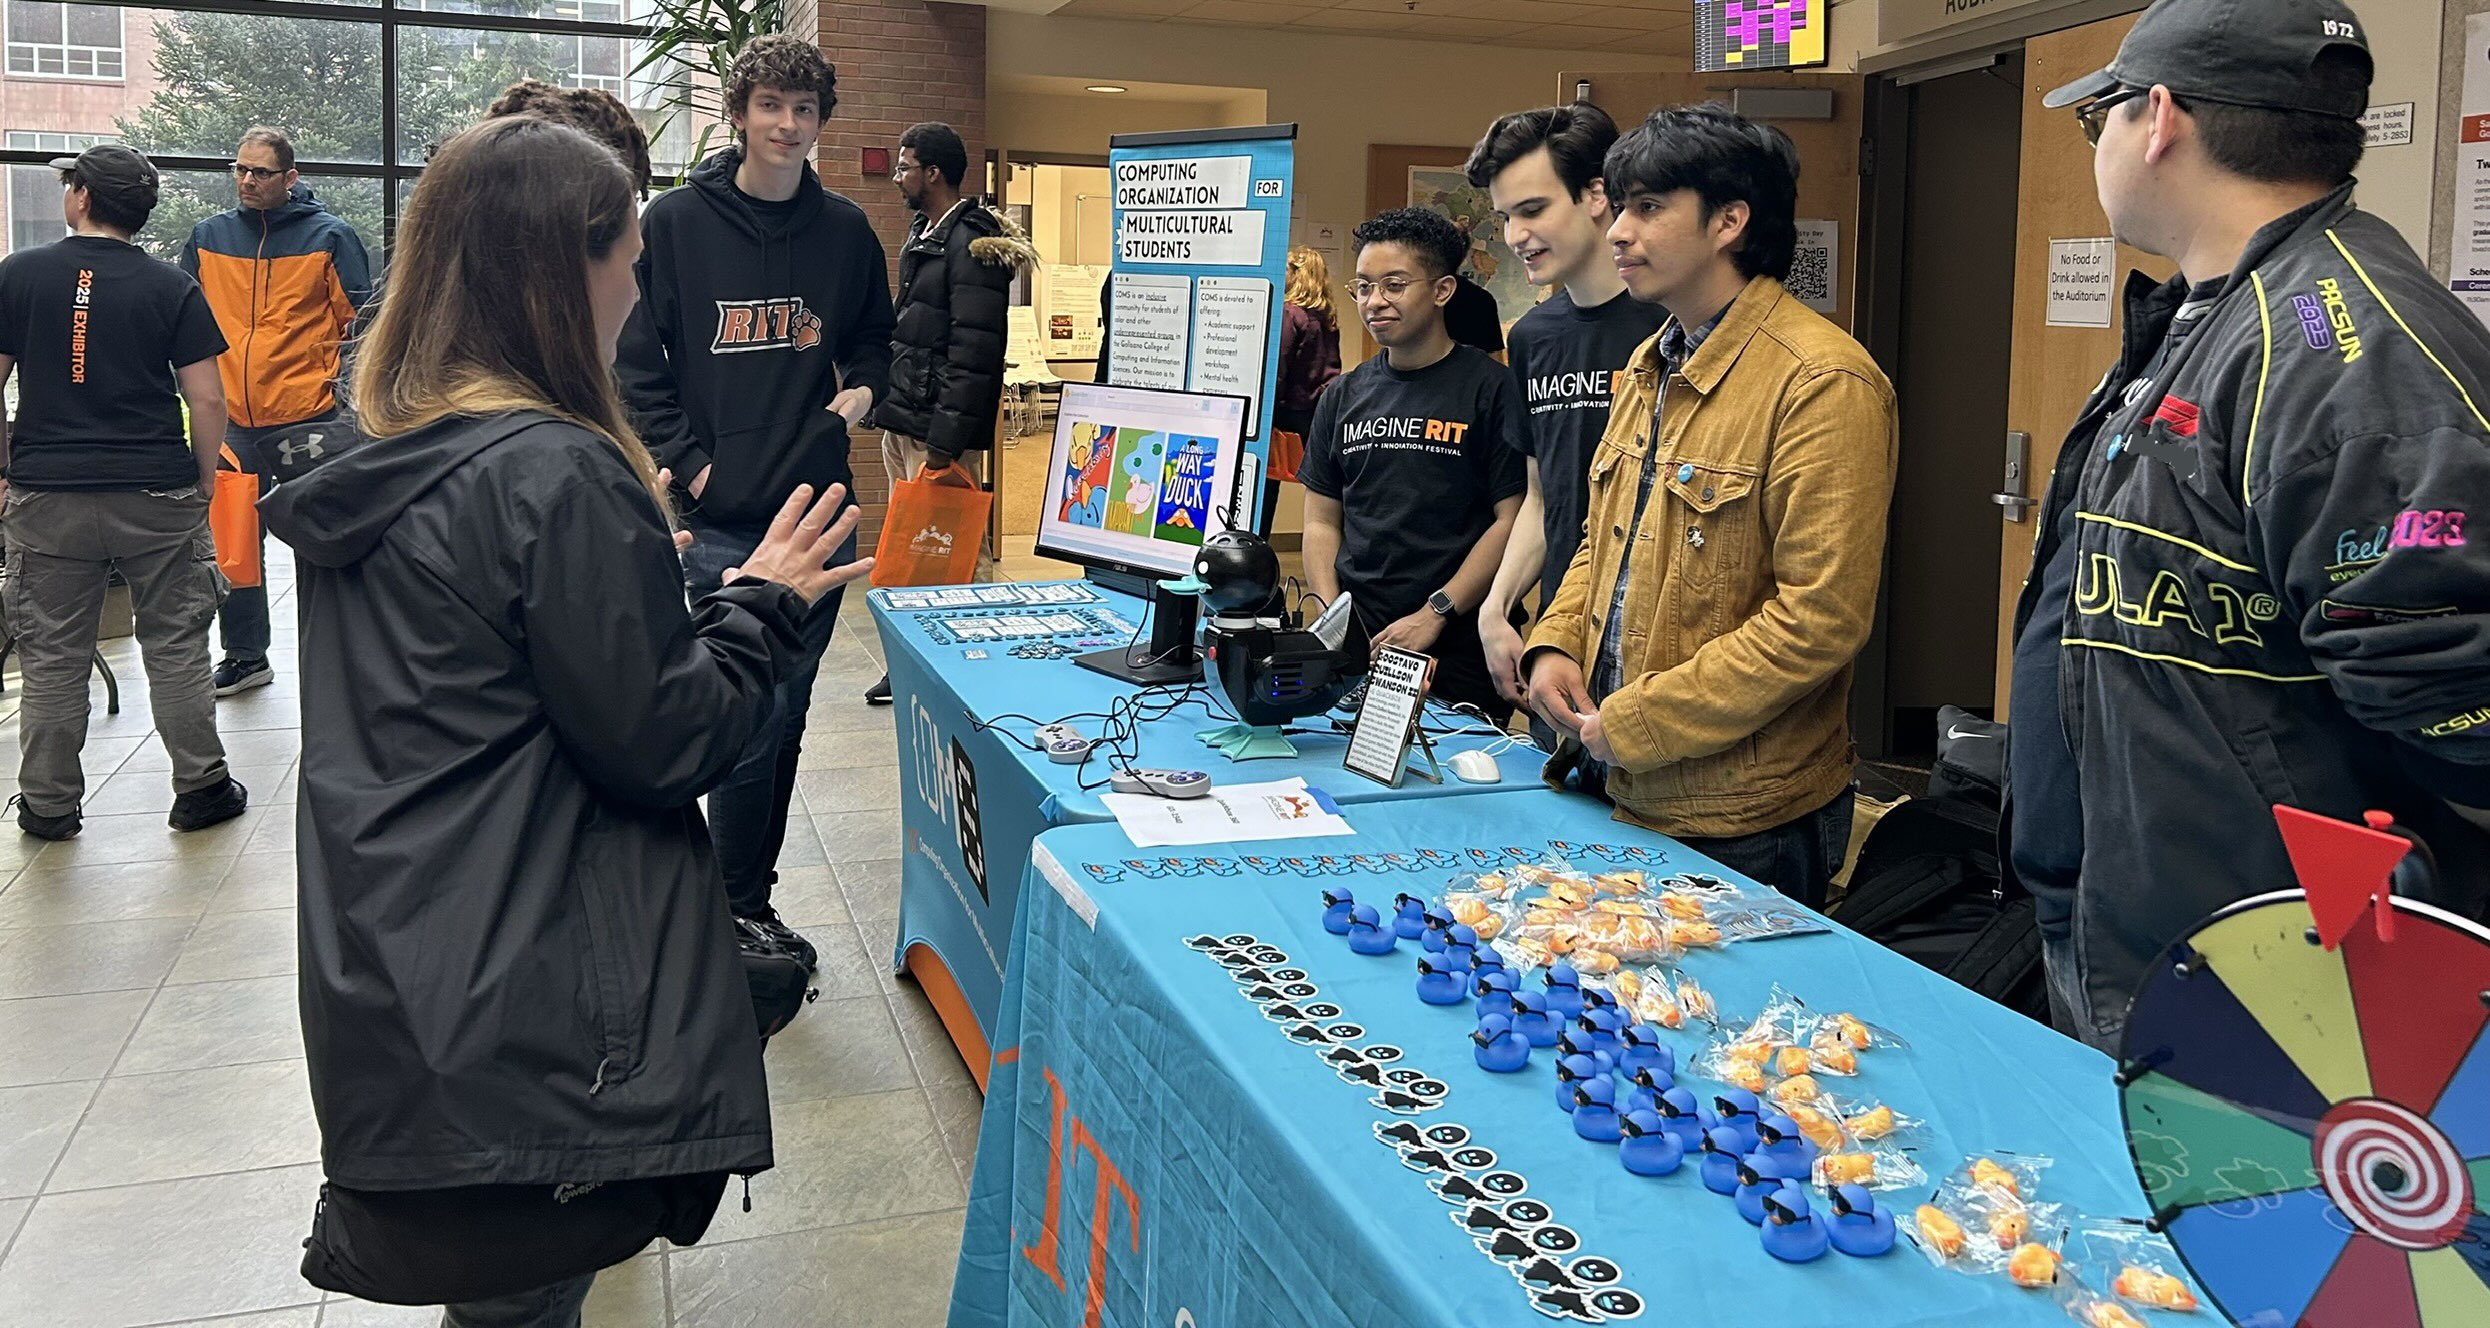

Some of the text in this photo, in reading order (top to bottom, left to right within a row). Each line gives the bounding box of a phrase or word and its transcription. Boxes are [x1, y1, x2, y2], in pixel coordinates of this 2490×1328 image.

[2321, 19, 2355, 38] 1972
[1118, 163, 1197, 181] COMPUTING
[1118, 182, 1278, 205] ORGANIZATION FOR
[1126, 215, 1233, 234] MULTICULTURAL
[1125, 241, 1191, 259] STUDENTS
[2060, 254, 2101, 265] No Food or
[2052, 272, 2109, 283] Drink allowed in
[75, 269, 93, 305] 2025
[1200, 293, 1218, 301] COMS
[2052, 290, 2106, 301] the Auditorium
[721, 304, 796, 344] RIT
[1208, 321, 1255, 331] Academic support
[2316, 278, 2363, 363] PACSUN
[1207, 333, 1237, 342] Professional
[72, 310, 88, 384] EXHIBITOR
[1144, 342, 1163, 353] College
[1206, 346, 1238, 357] development
[1151, 356, 1180, 366] Information
[1205, 362, 1230, 370] workshops
[1133, 366, 1143, 375] Our
[1204, 373, 1221, 381] Mental
[1527, 370, 1609, 402] IMAGINE
[1343, 416, 1468, 444] IMAGINE RIT
[1425, 445, 1462, 456] FESTIVAL
[1177, 453, 1202, 475] WAY
[1163, 475, 1204, 509] DUCK
